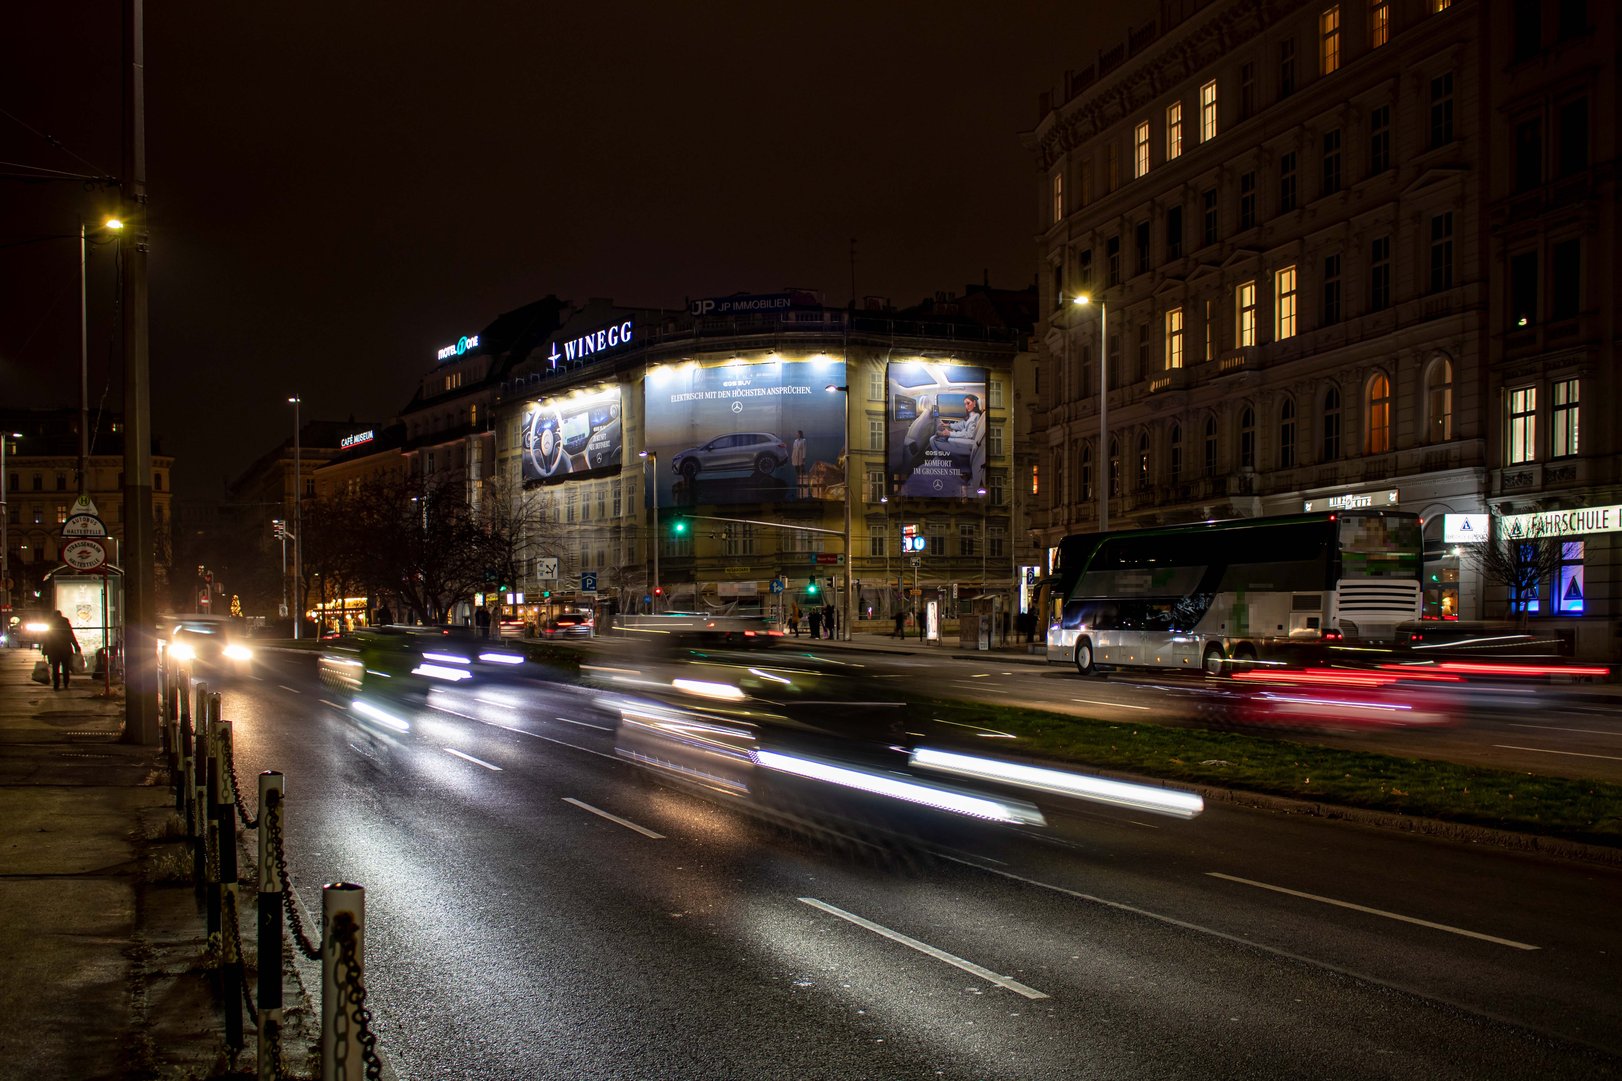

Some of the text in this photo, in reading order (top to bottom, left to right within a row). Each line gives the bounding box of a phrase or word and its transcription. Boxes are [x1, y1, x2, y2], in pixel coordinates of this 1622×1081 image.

[691, 300, 715, 315] JP
[718, 298, 791, 312] JP IMMOBILIEN
[437, 344, 457, 360] MOTEL
[466, 335, 479, 349] ONE
[563, 321, 632, 361] WINEGG
[671, 385, 812, 403] ELEKTRISCH MIT DEN HÖCHSTEN ANSPRÜCHEN.
[341, 430, 374, 447] CAFÉ MUSEUM
[924, 459, 952, 467] KOMFORT
[913, 467, 921, 475] IM
[921, 467, 949, 476] GROSSEN
[72, 517, 97, 526] AUTOBUS
[1531, 510, 1609, 535] FAHRSCHULE
[67, 542, 102, 553] STRASSENBAHN
[69, 558, 100, 568] HALTESTELLE
